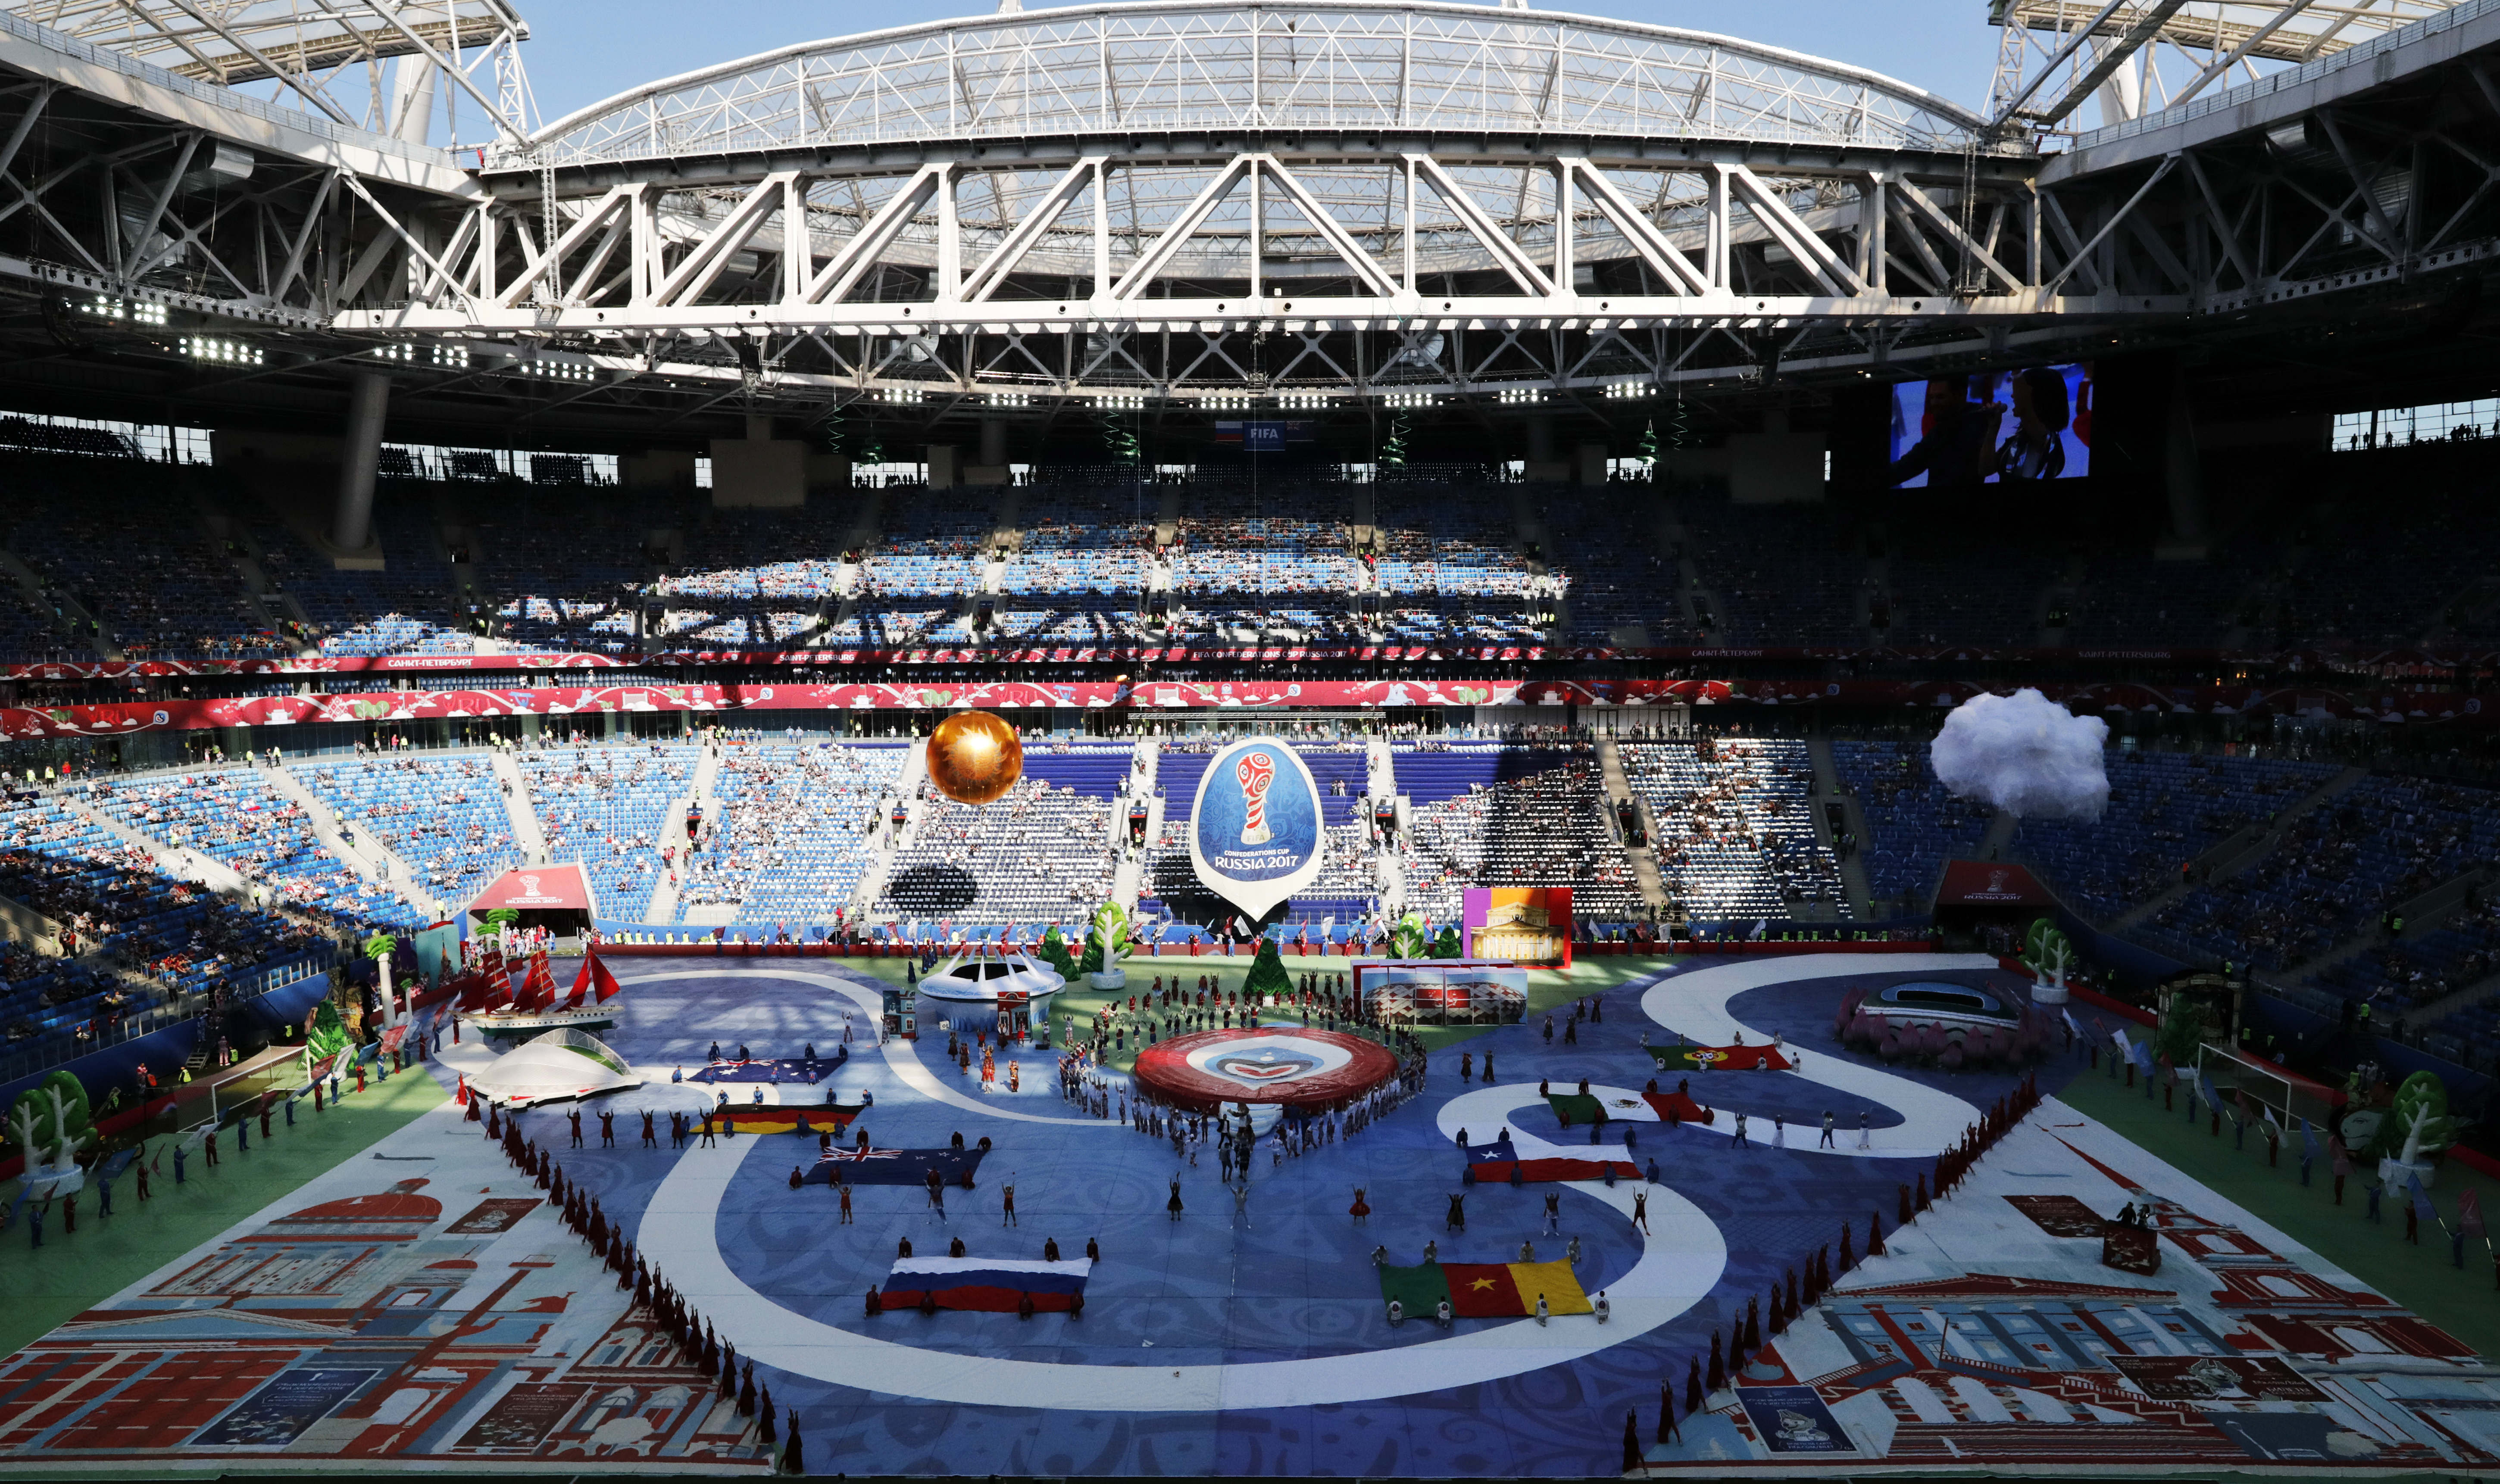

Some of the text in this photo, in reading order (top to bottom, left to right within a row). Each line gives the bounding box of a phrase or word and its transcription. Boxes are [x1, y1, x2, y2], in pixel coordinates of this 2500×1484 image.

[1250, 428, 1278, 439] FIFA
[2078, 651, 2171, 659] SAINT-PETERSBURG
[388, 658, 473, 667] САНКТ-ПЕТЕРБУРГ
[1215, 856, 1299, 870] RUSSIA 2017
